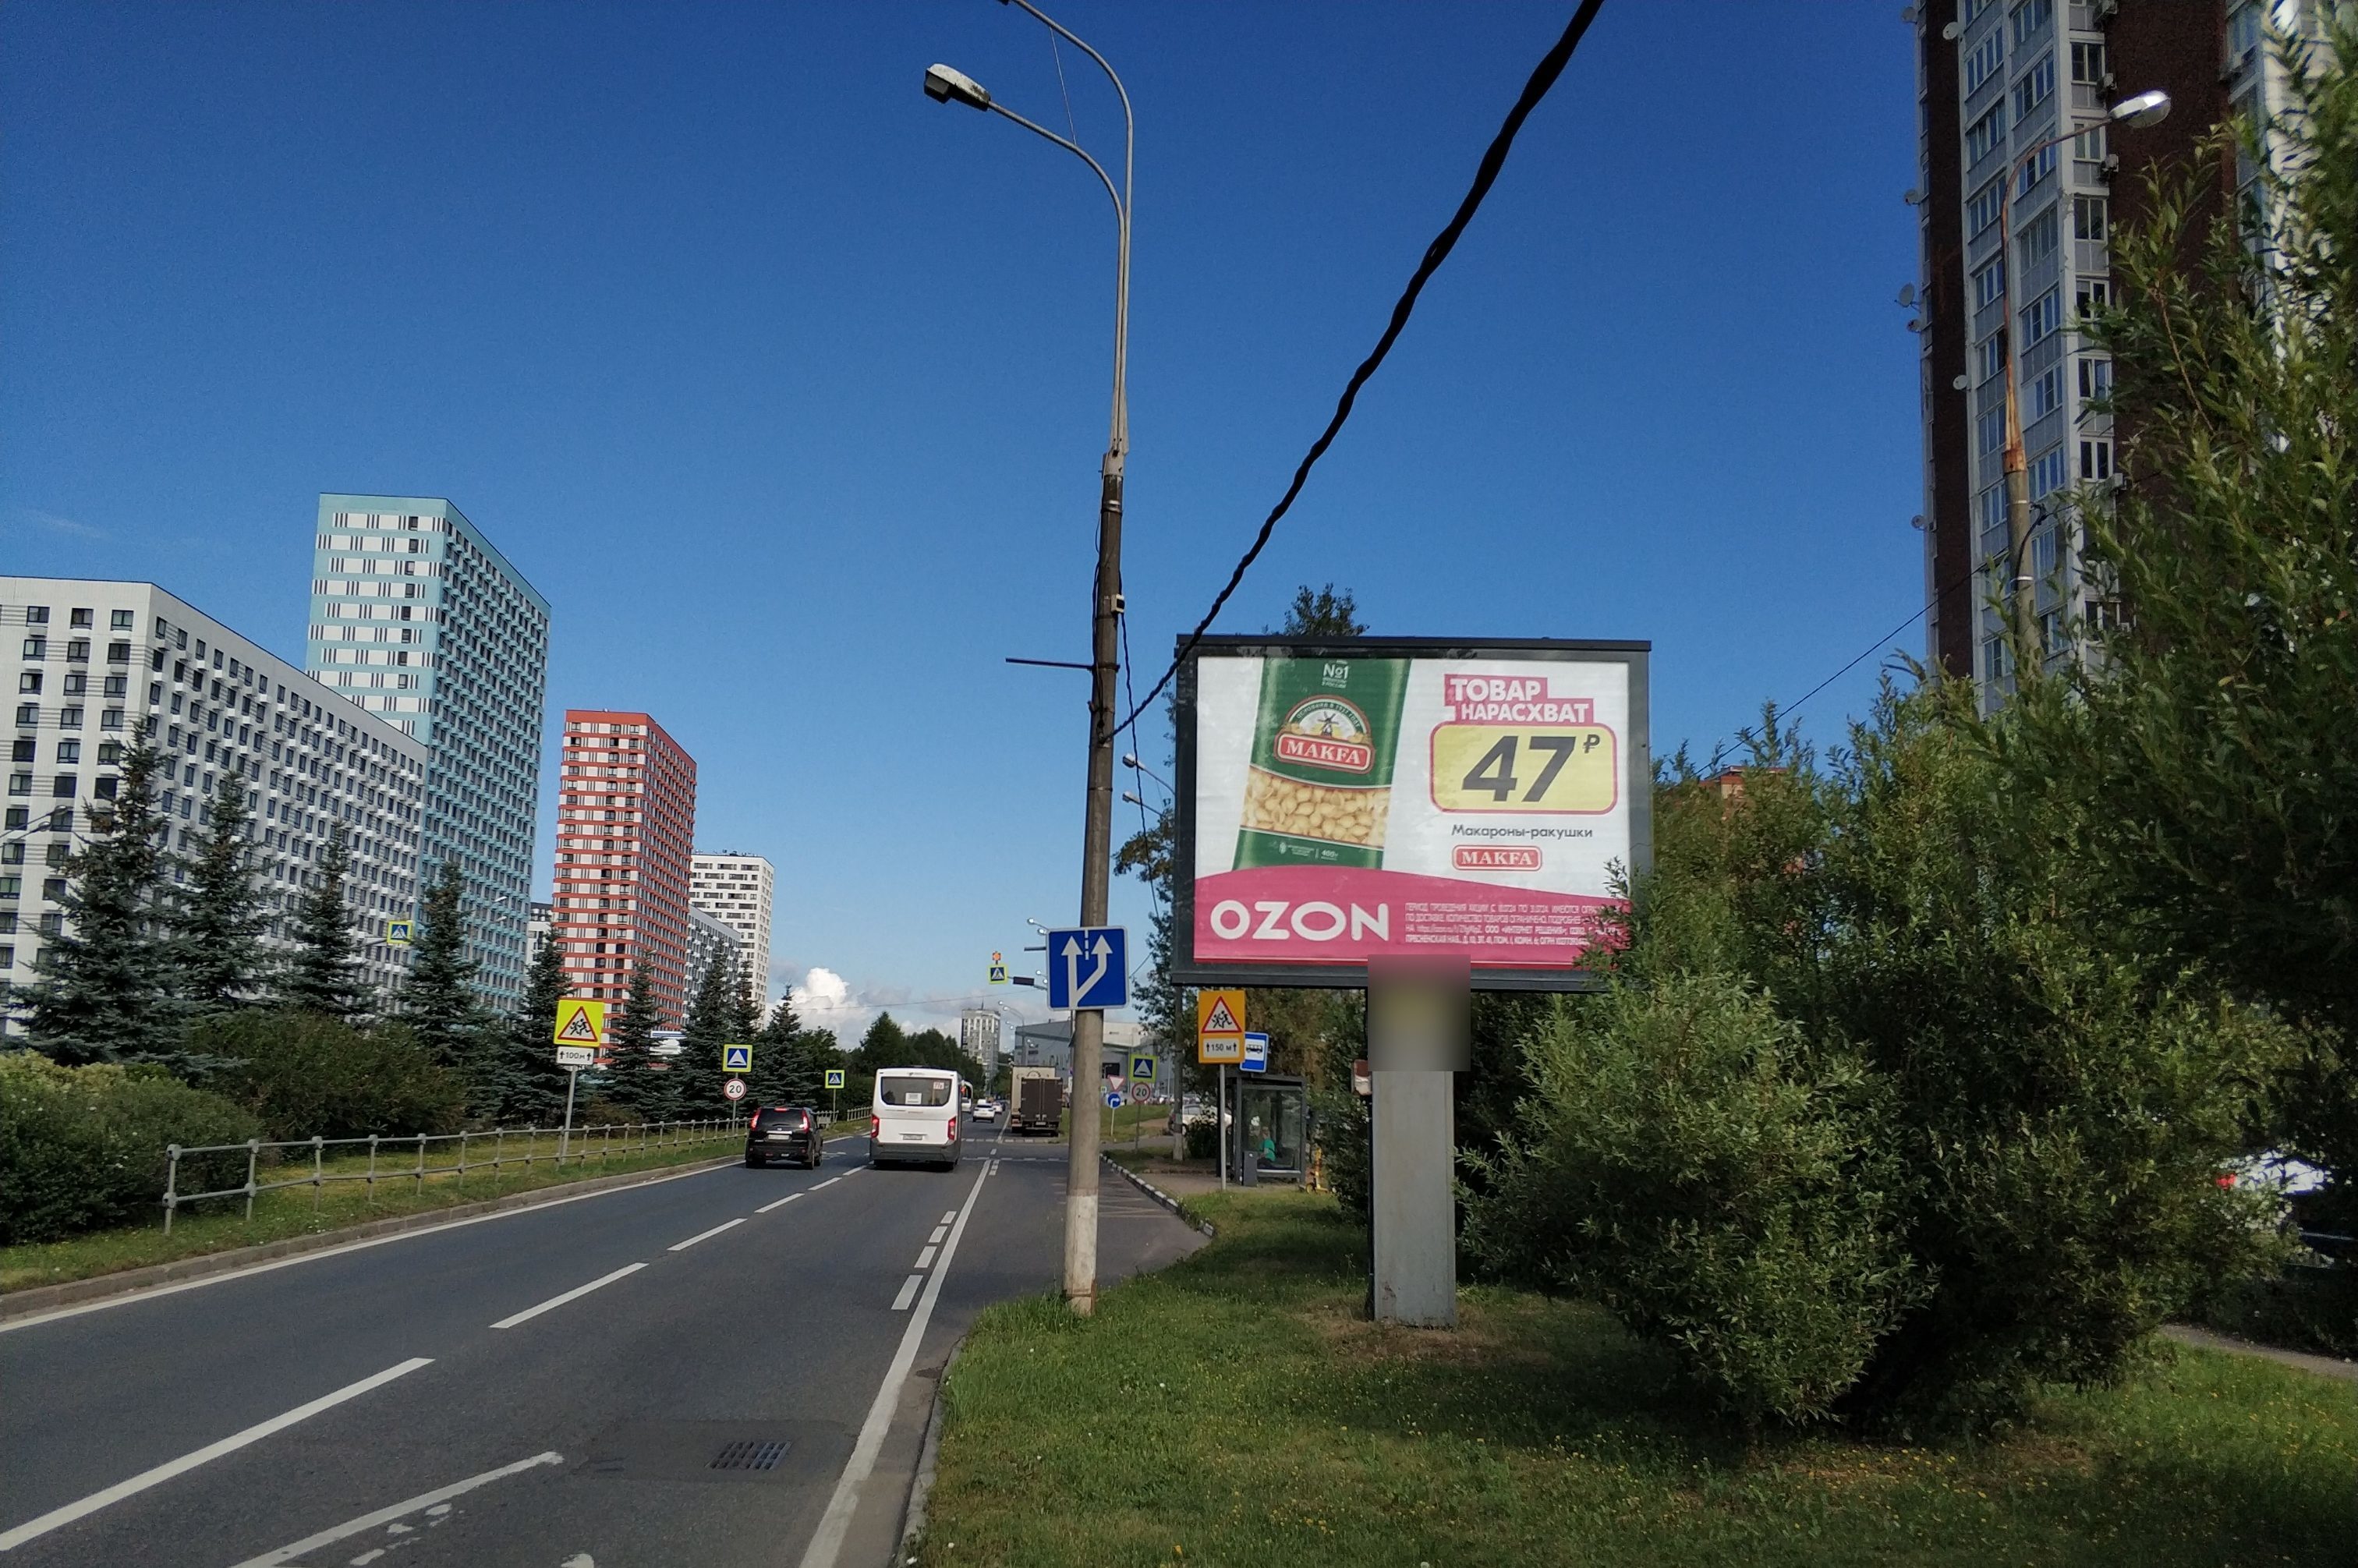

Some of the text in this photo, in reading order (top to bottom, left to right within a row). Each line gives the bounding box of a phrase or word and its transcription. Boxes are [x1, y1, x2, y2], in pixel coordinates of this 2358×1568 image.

[1450, 678, 1541, 701] ТОВАР
[1461, 703, 1590, 723] НАРАСХВАТ
[1285, 739, 1361, 765] MAKFA
[1461, 735, 1576, 802] 47
[1451, 823, 1593, 840] Макароны-ракушки
[1461, 851, 1532, 865] MAKFA
[1210, 900, 1390, 942] OZON
[728, 1085, 742, 1094] 20
[1136, 1087, 1147, 1097] 20
